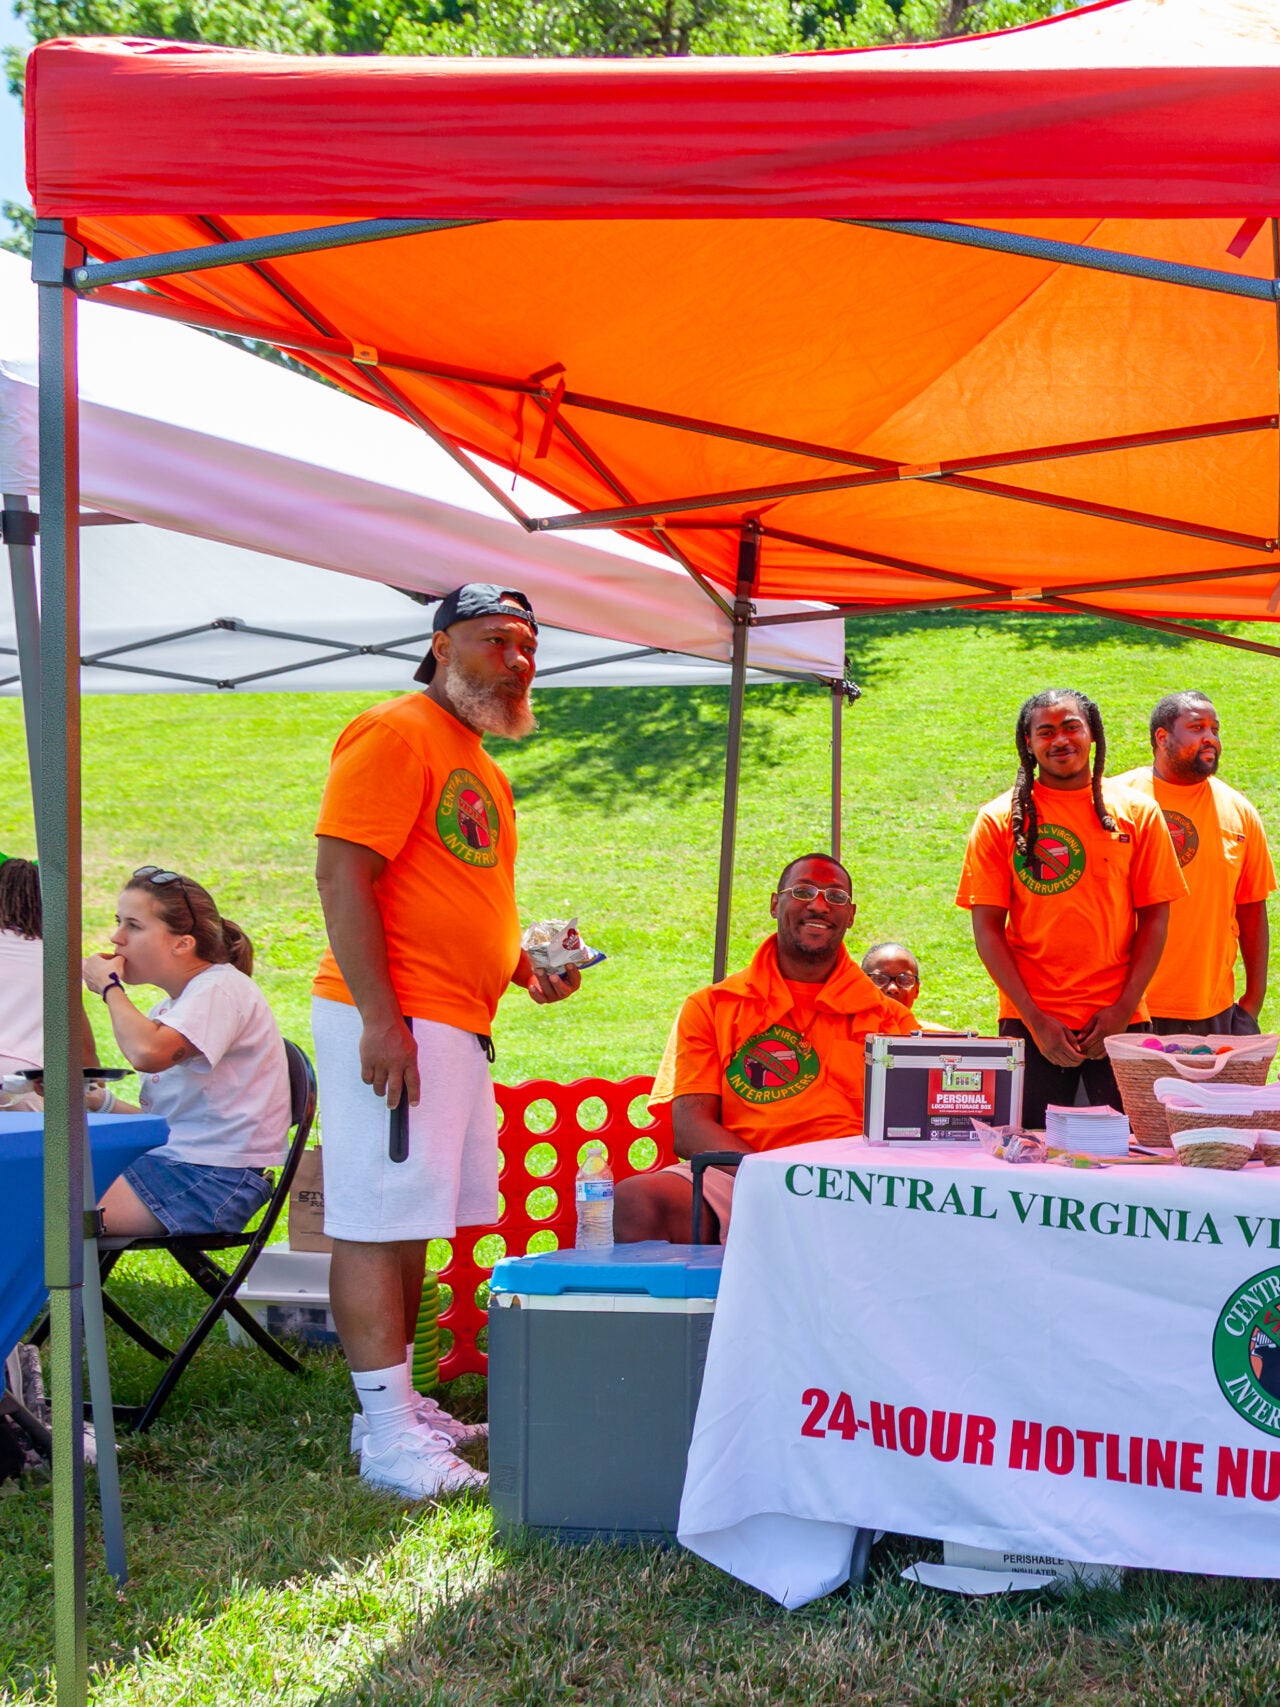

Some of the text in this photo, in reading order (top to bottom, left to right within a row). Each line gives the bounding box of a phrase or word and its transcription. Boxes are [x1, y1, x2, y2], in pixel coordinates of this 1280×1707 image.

[1051, 827, 1081, 856] VIRGINIA
[730, 1073, 816, 1102] INTERRUPTERS
[936, 1093, 987, 1104] PERSONAL
[783, 1163, 999, 1221] CENTRAL
[1007, 1189, 1224, 1246] VIRGINIA
[800, 1387, 997, 1467] 24-HOUR
[1008, 1418, 1205, 1494] HOTLINE
[1003, 1554, 1065, 1566] PERISHABLE
